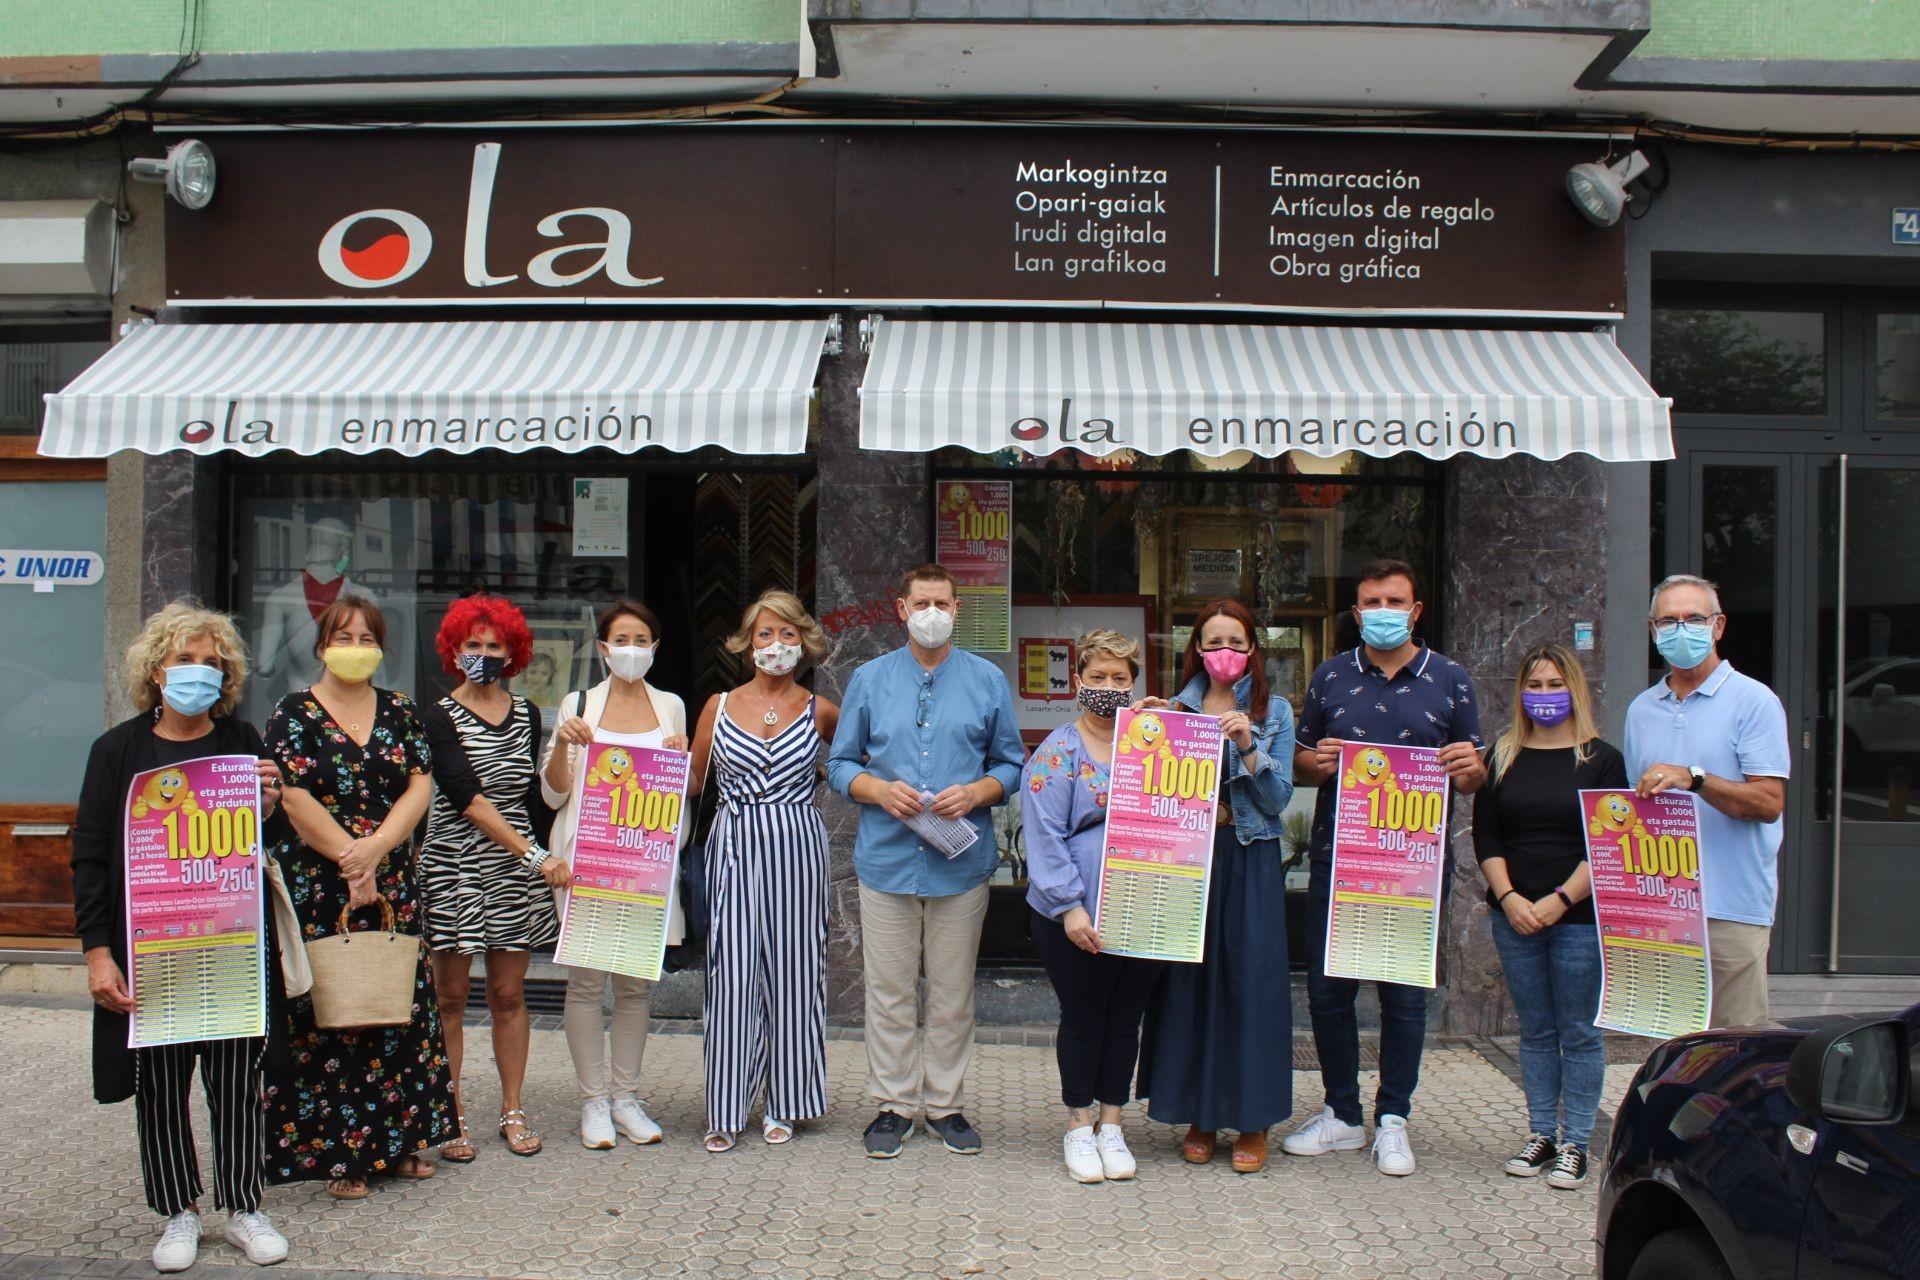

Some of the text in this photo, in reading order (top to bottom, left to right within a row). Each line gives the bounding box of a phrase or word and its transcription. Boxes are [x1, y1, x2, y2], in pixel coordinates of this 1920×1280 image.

[1015, 159, 1167, 189] Markogintza
[1270, 166, 1420, 189] Enmarcación
[1015, 190, 1166, 219] Opari-gaiak
[1271, 194, 1495, 226] Artículos de regalo
[319, 142, 664, 288] ola
[1015, 219, 1166, 249] Irudi digitala
[1269, 225, 1439, 254] Imagen digital
[1015, 250, 1166, 278] Lan grafikoa
[1270, 253, 1420, 283] Obra gráfica
[179, 401, 652, 444] ola enmarcación
[1010, 398, 1516, 448] ola enmarcación
[16, 557, 91, 578] UNIOR
[1193, 564, 1236, 573] MEDIDA
[1026, 705, 1071, 713] Lasarte-Oria
[1193, 730, 1220, 740] 1.000€
[1174, 739, 1218, 750] eta gastatu
[653, 754, 687, 765] Eskuratu
[1178, 749, 1217, 760] 3 ordutan
[211, 762, 254, 773] Eskuratu
[660, 764, 686, 775] 1.000€
[221, 774, 255, 784] 1.000€
[655, 775, 684, 784] gastatu
[1413, 774, 1444, 783] gastatu
[200, 787, 255, 799] eta gastatu
[645, 782, 682, 794] 3 ordutan
[1404, 782, 1443, 793] 3 ordutan
[207, 798, 256, 809] 3 ordutan
[1655, 797, 1693, 806] Eskuratu
[1664, 807, 1695, 817] 1.000€
[1662, 819, 1695, 827] gastatu
[1661, 828, 1696, 838] ordutan
[135, 843, 165, 853] gástalos
[140, 852, 145, 860] 3
[146, 851, 168, 860] horas!
